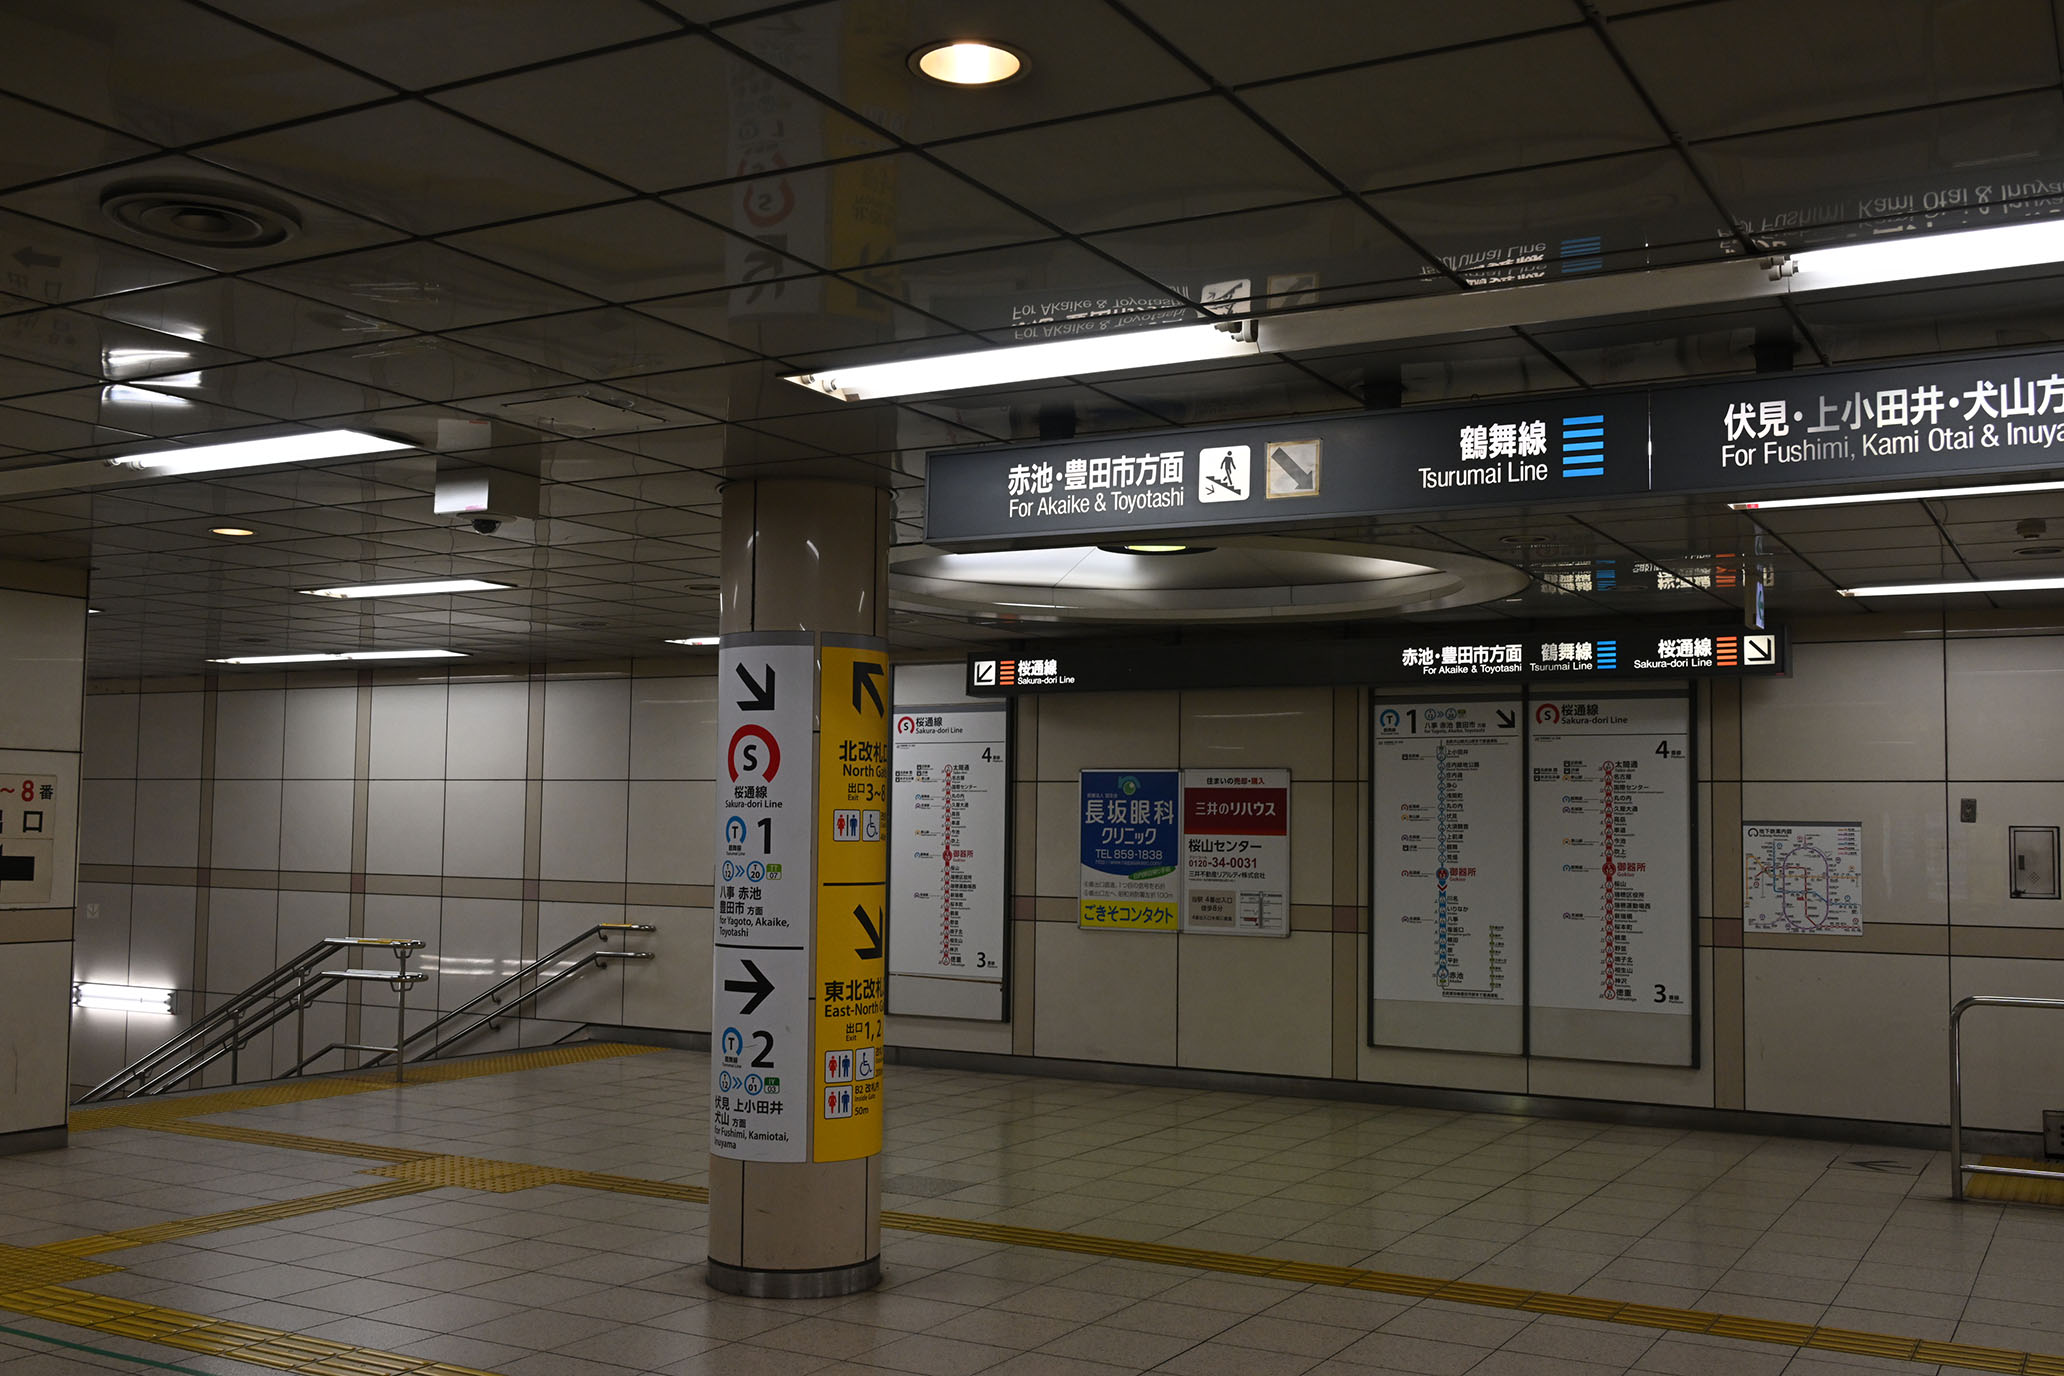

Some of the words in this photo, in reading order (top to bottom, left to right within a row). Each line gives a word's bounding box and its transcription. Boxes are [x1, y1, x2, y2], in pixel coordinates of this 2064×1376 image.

[1459, 420, 1547, 461] 鶴舞線
[1722, 444, 1754, 467] For
[1763, 437, 1856, 464] Fushimi,
[1862, 433, 1920, 456] Kami
[1928, 426, 1975, 450] Otai
[1981, 423, 2000, 448] &
[1008, 450, 1185, 498] 赤池・豊田市方面
[1418, 464, 1503, 488] Tsurumai
[1507, 461, 1548, 483] Line
[1009, 497, 1034, 518] For
[1037, 493, 1090, 516] Akaike
[1094, 491, 1107, 511] &
[1111, 486, 1185, 511] Toyotashi
[1540, 642, 1593, 662] 鶴舞線
[1657, 637, 1712, 659] 桜通線
[1402, 644, 1523, 667] 赤池・豊田市方面
[1017, 659, 1058, 677] 桜通線
[1422, 665, 1437, 675] For
[1438, 664, 1469, 675] Akaike
[1471, 664, 1479, 674] &
[1480, 663, 1523, 674] Toyotashi
[1529, 662, 1571, 673] Tsurumai
[1572, 661, 1593, 672] Line
[1633, 658, 1689, 669] Sakura-dori
[1691, 657, 1712, 668] Line
[1017, 676, 1058, 685] Sakura-dori
[1059, 676, 1076, 685] Line
[1544, 710, 1551, 721] S
[1561, 704, 1599, 716] 桜通線
[904, 722, 909, 730] S
[915, 717, 943, 727] 桜通線
[1386, 715, 1393, 724] T
[1406, 709, 1416, 734] 1
[1610, 716, 1628, 724] Line
[981, 747, 992, 762] 4
[1655, 740, 1669, 759] 4
[743, 745, 758, 771] S
[843, 765, 874, 778] North
[734, 786, 768, 798] 桜通線
[847, 783, 865, 793] 出口
[725, 800, 763, 809] Sakura-dori
[764, 800, 783, 808] Line
[1194, 802, 1277, 816] 三井のリハウス
[1085, 799, 1175, 825] 長坂眼科
[732, 826, 739, 839] T
[757, 818, 772, 854] 1
[1101, 827, 1157, 845] クリニック
[1188, 839, 1262, 853] 桜山センター
[1095, 849, 1113, 859] TEL
[1188, 857, 1257, 868] 0120-34-0031
[725, 871, 731, 879] 12
[750, 871, 761, 879] 20
[719, 886, 735, 899] 八事
[738, 887, 762, 900] 赤池
[719, 901, 745, 915] 豊田市
[1084, 905, 1174, 924] ごきそコンタクト
[727, 917, 754, 928] Yagoto,
[755, 917, 790, 928] Akaike,
[719, 926, 749, 939] Toyotashi
[976, 952, 986, 968] 3
[1654, 984, 1667, 1003] 3
[824, 1002, 878, 1018] East-North
[846, 1022, 863, 1034] 出口
[727, 1037, 735, 1050] T
[846, 1034, 857, 1042] Exit
[751, 1030, 774, 1068] 2
[722, 1081, 729, 1089] 12
[748, 1084, 758, 1092] 01
[714, 1095, 730, 1111] 伏見
[733, 1099, 784, 1115] 上小田井
[854, 1106, 870, 1116] 50m
[714, 1111, 730, 1126] 犬山
[721, 1126, 747, 1140] Fushimi,
[748, 1130, 789, 1142] Kamiotai,
